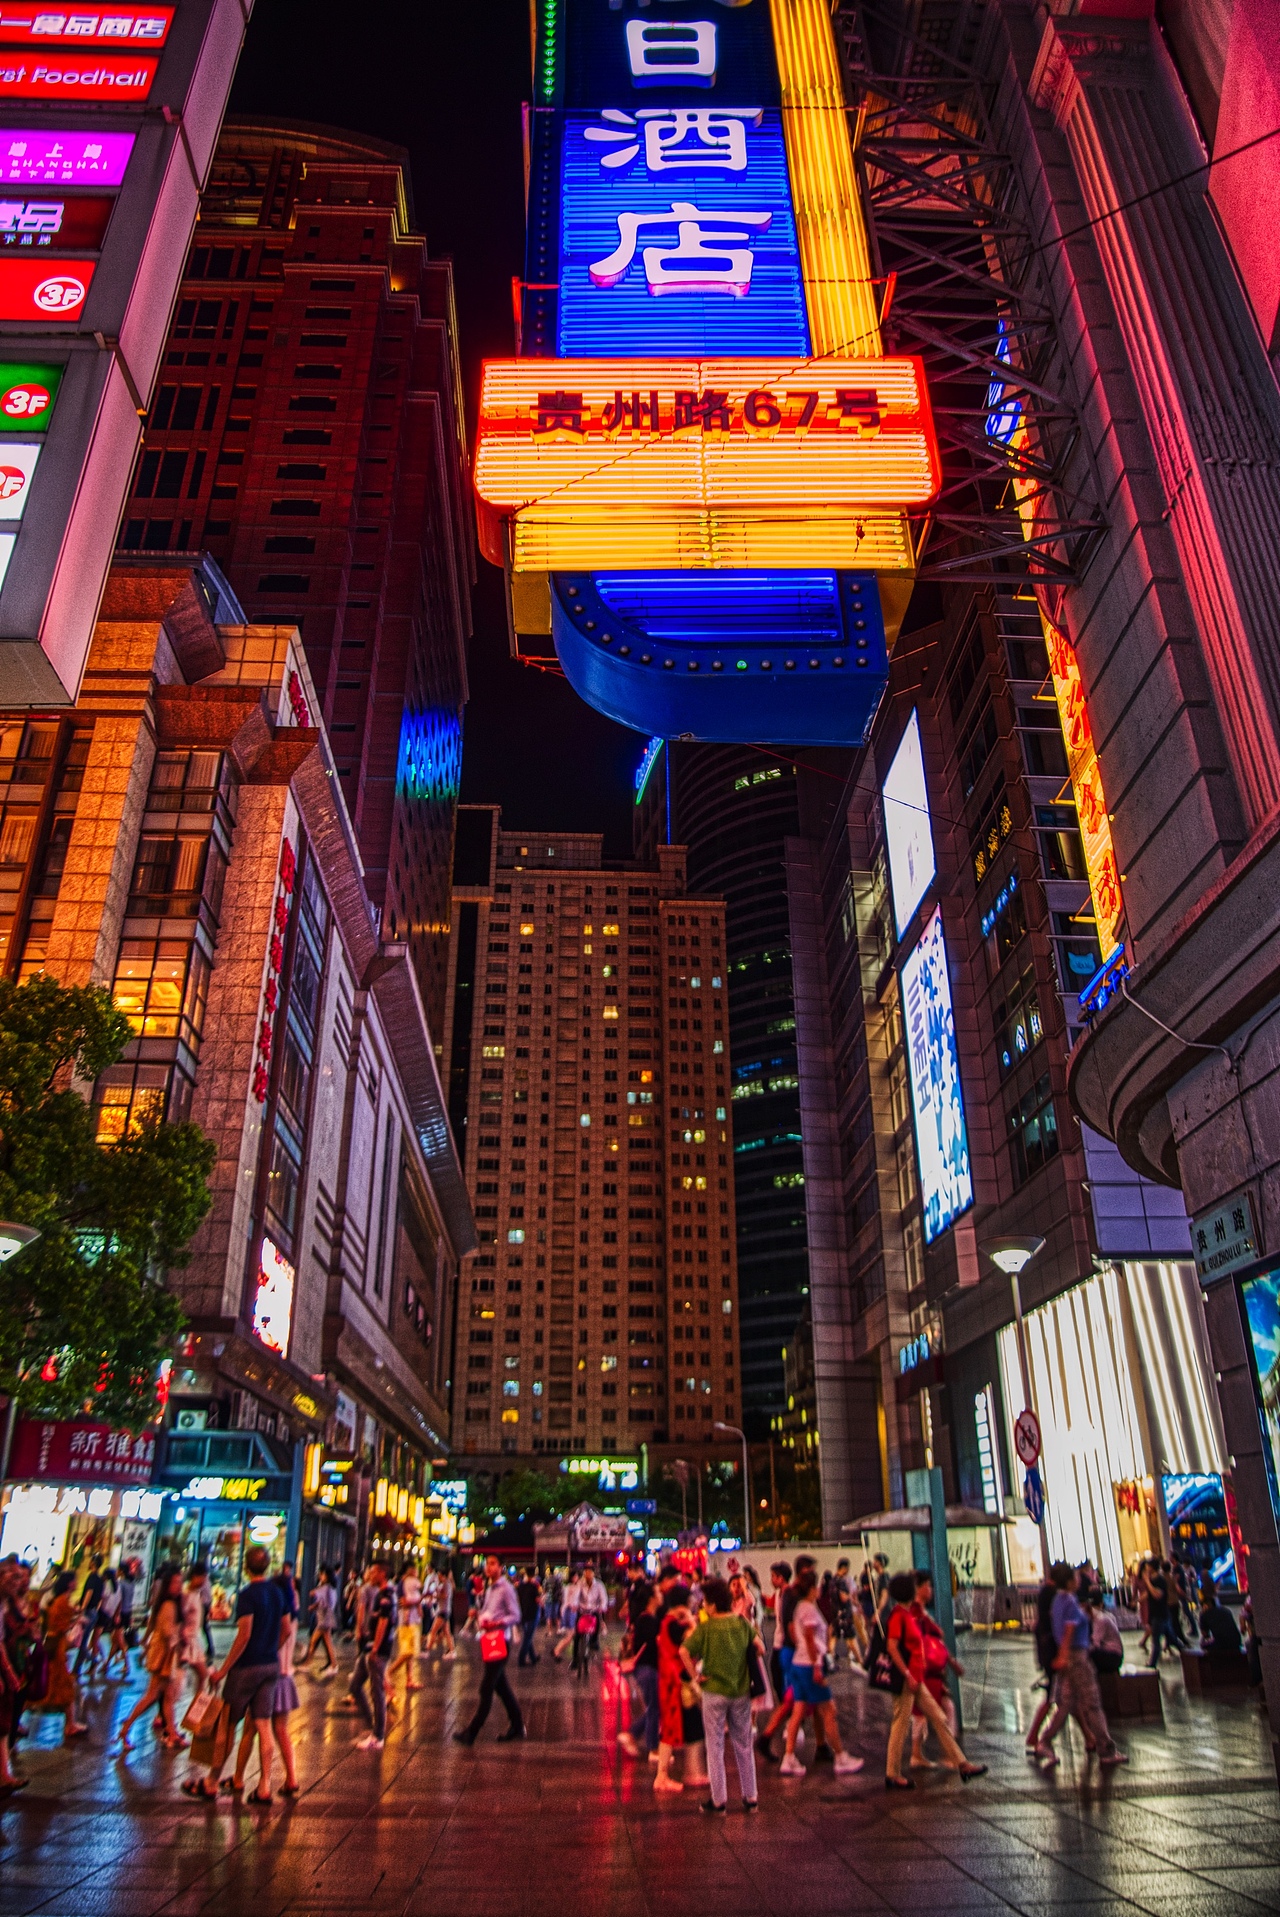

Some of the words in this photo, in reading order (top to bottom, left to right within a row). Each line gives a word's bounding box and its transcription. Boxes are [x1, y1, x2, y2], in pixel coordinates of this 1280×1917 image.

[31, 66, 147, 86] Foodhall
[584, 0, 773, 296] 日酒店
[41, 285, 80, 305] 3F
[6, 391, 48, 414] 3F
[530, 389, 886, 444] 贵州路67号
[1196, 1207, 1245, 1253] 贵州路
